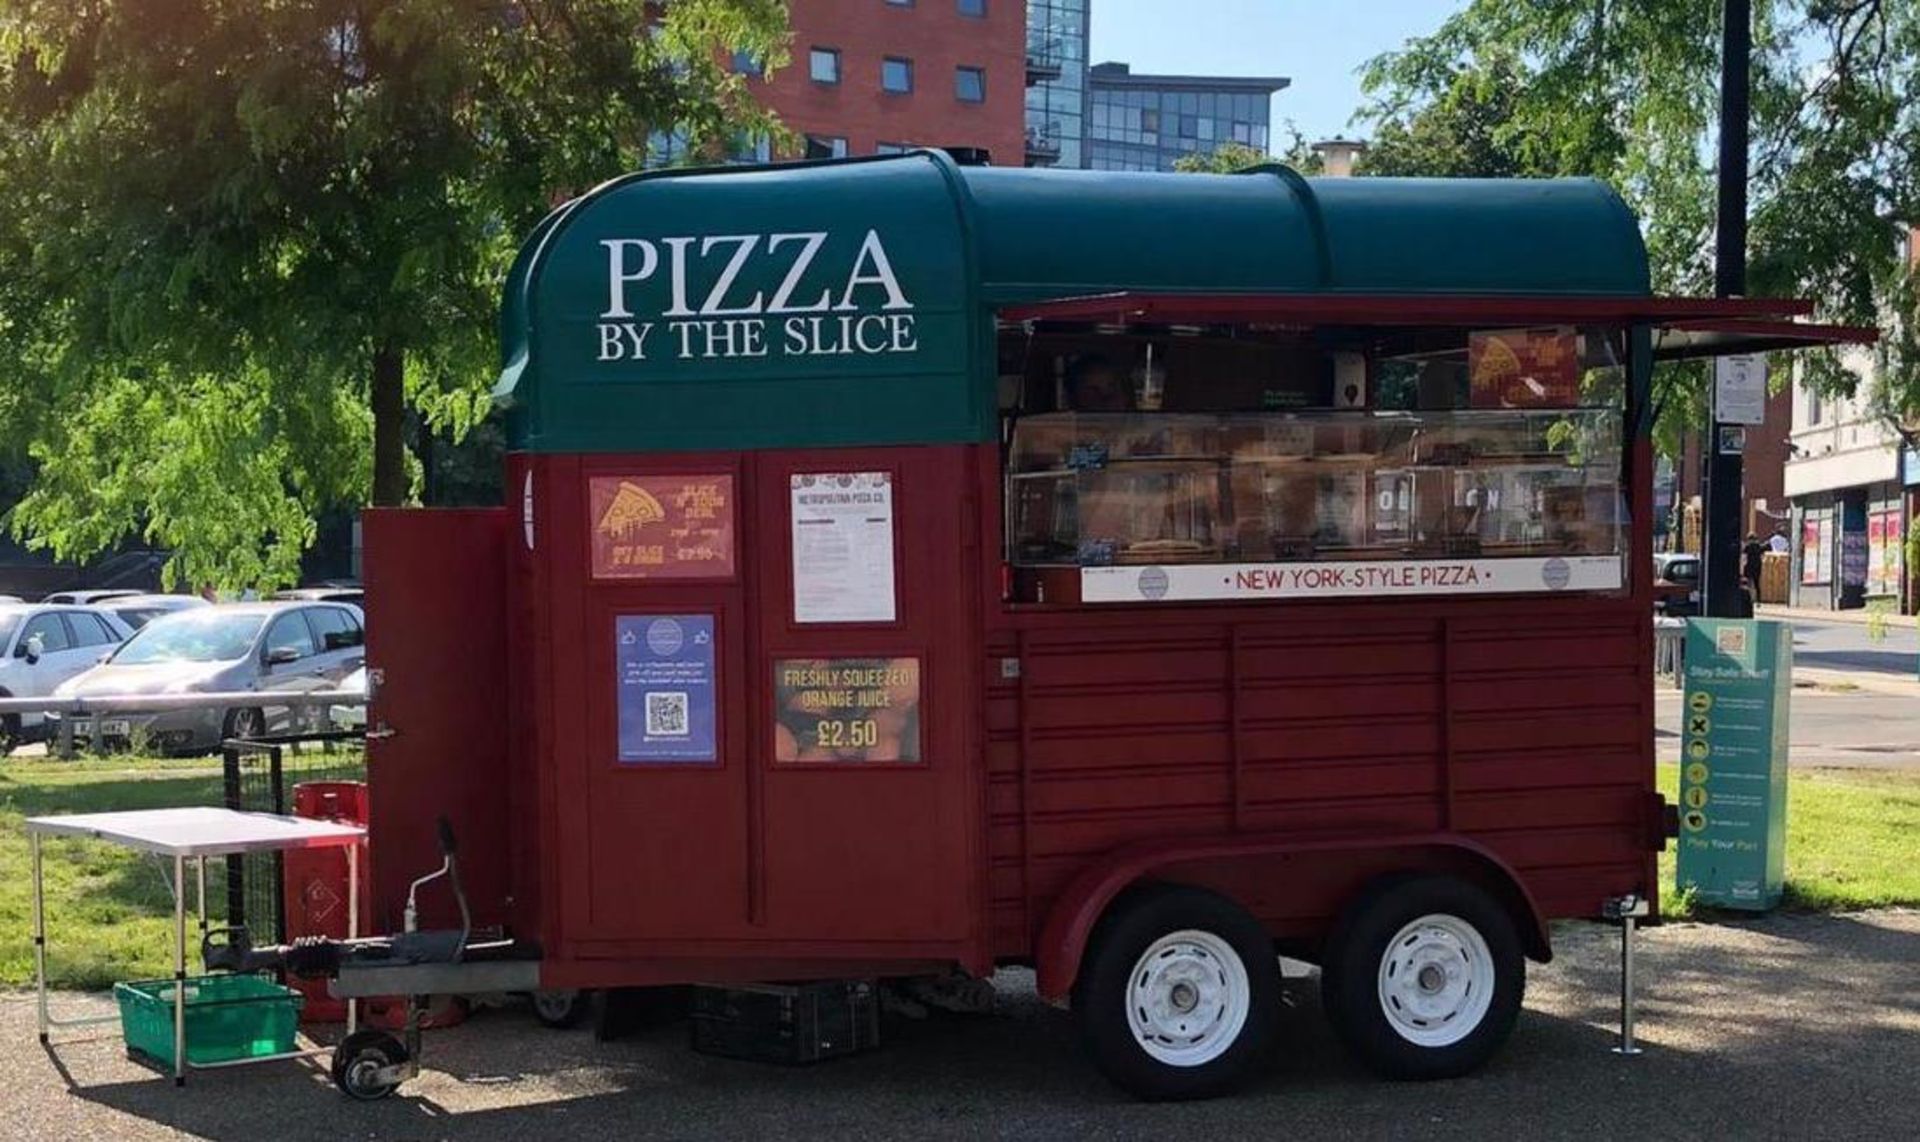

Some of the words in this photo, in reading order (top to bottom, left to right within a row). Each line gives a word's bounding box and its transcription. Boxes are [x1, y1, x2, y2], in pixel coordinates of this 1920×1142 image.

[600, 229, 914, 317] PIZZA
[597, 322, 653, 361] BY
[669, 319, 768, 358] THE
[784, 314, 917, 355] SLICE
[1236, 570, 1283, 590] NEW
[1289, 566, 1415, 589] YORK-STYLE
[1421, 565, 1479, 586] PIZZA
[784, 670, 840, 687] FRESHLY
[842, 668, 909, 687] SQUEEZED
[801, 690, 853, 708] ORANGE
[857, 690, 891, 707] JUICE
[817, 719, 877, 747] £2.50
